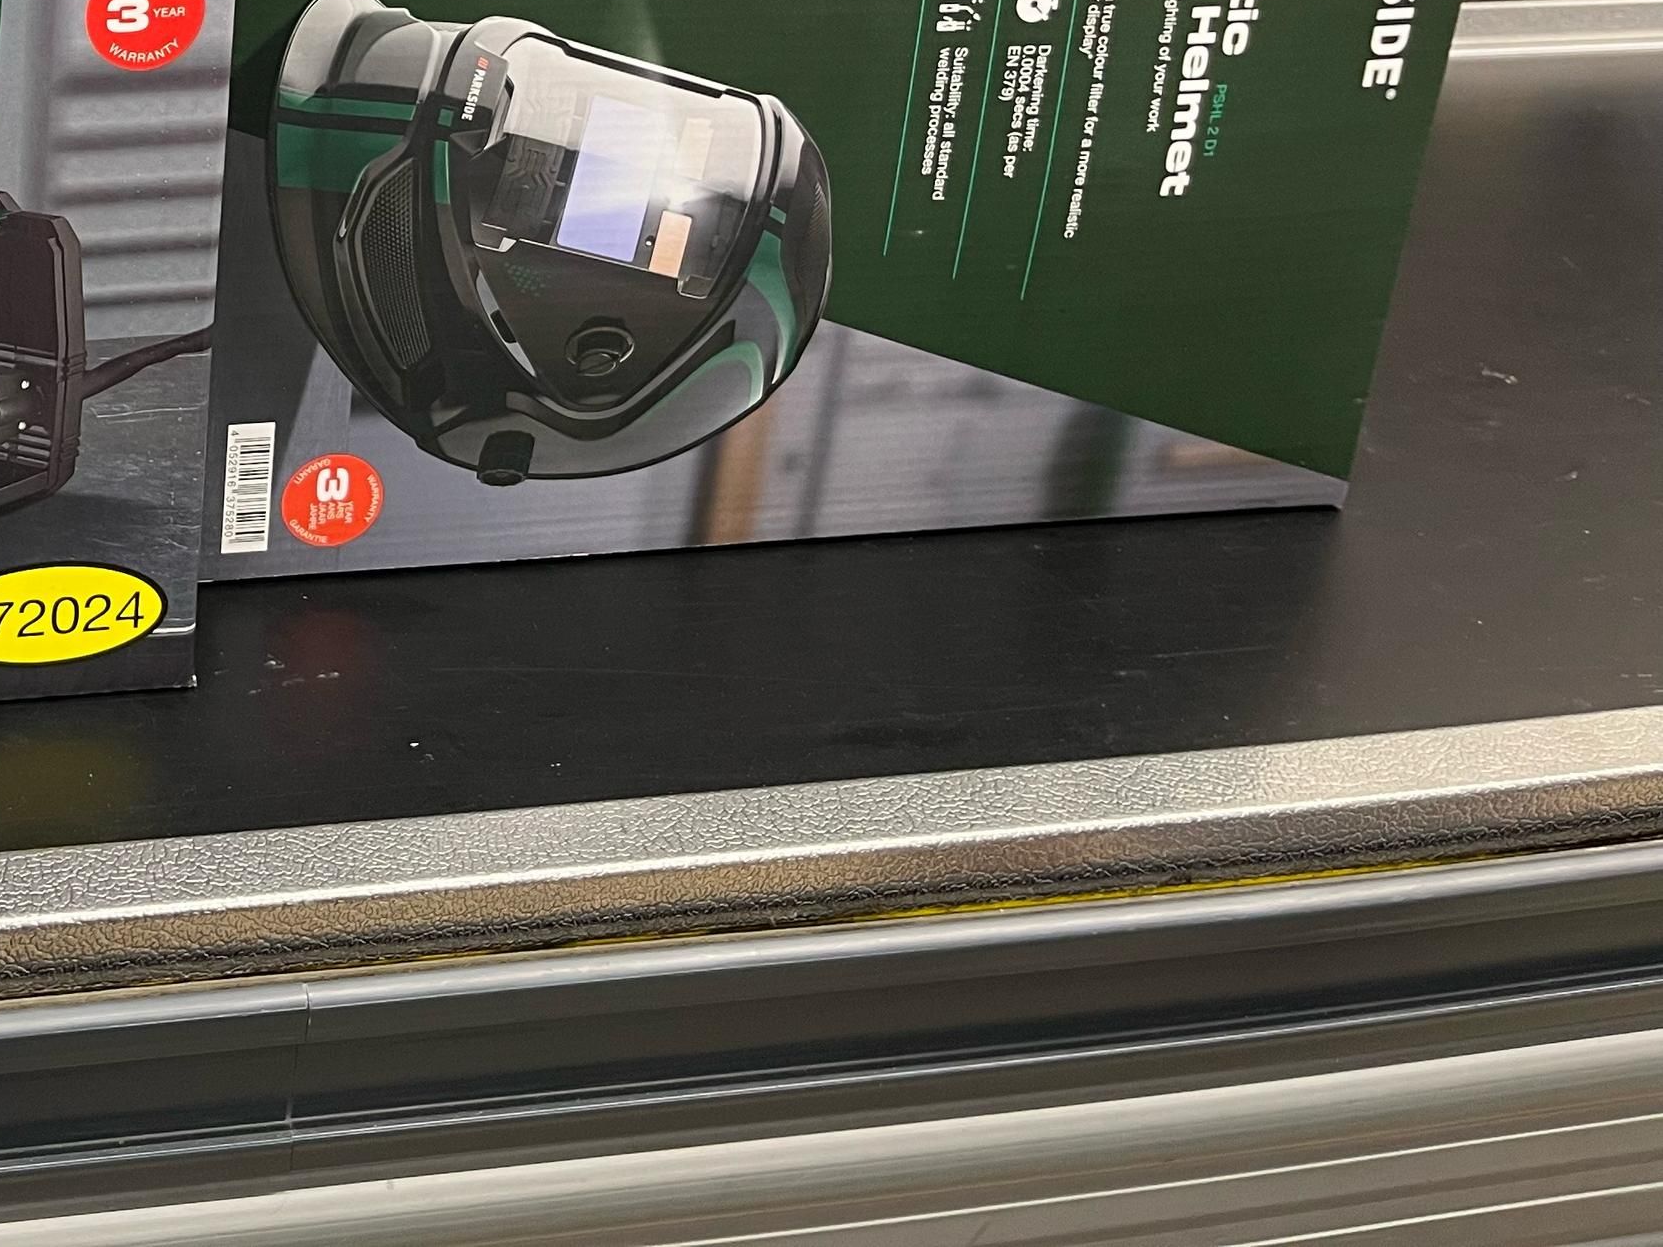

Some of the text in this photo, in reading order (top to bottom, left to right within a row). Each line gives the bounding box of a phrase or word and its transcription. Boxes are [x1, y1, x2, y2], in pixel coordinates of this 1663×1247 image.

[153, 5, 186, 19] YEAR
[1099, 3, 1117, 33] true
[109, 38, 180, 63] WARRANTY
[1095, 36, 1110, 80] colour
[1158, 46, 1171, 61] of
[1152, 63, 1167, 95] your
[921, 47, 951, 175] welding processes
[1088, 83, 1104, 113] filter
[1146, 98, 1161, 132] work
[1160, 5, 1222, 197] Helmet
[932, 47, 969, 201] Suitability: all standard
[1084, 115, 1099, 136] for
[1075, 152, 1091, 186] more
[1063, 188, 1083, 239] realistic
[316, 468, 350, 502] 3
